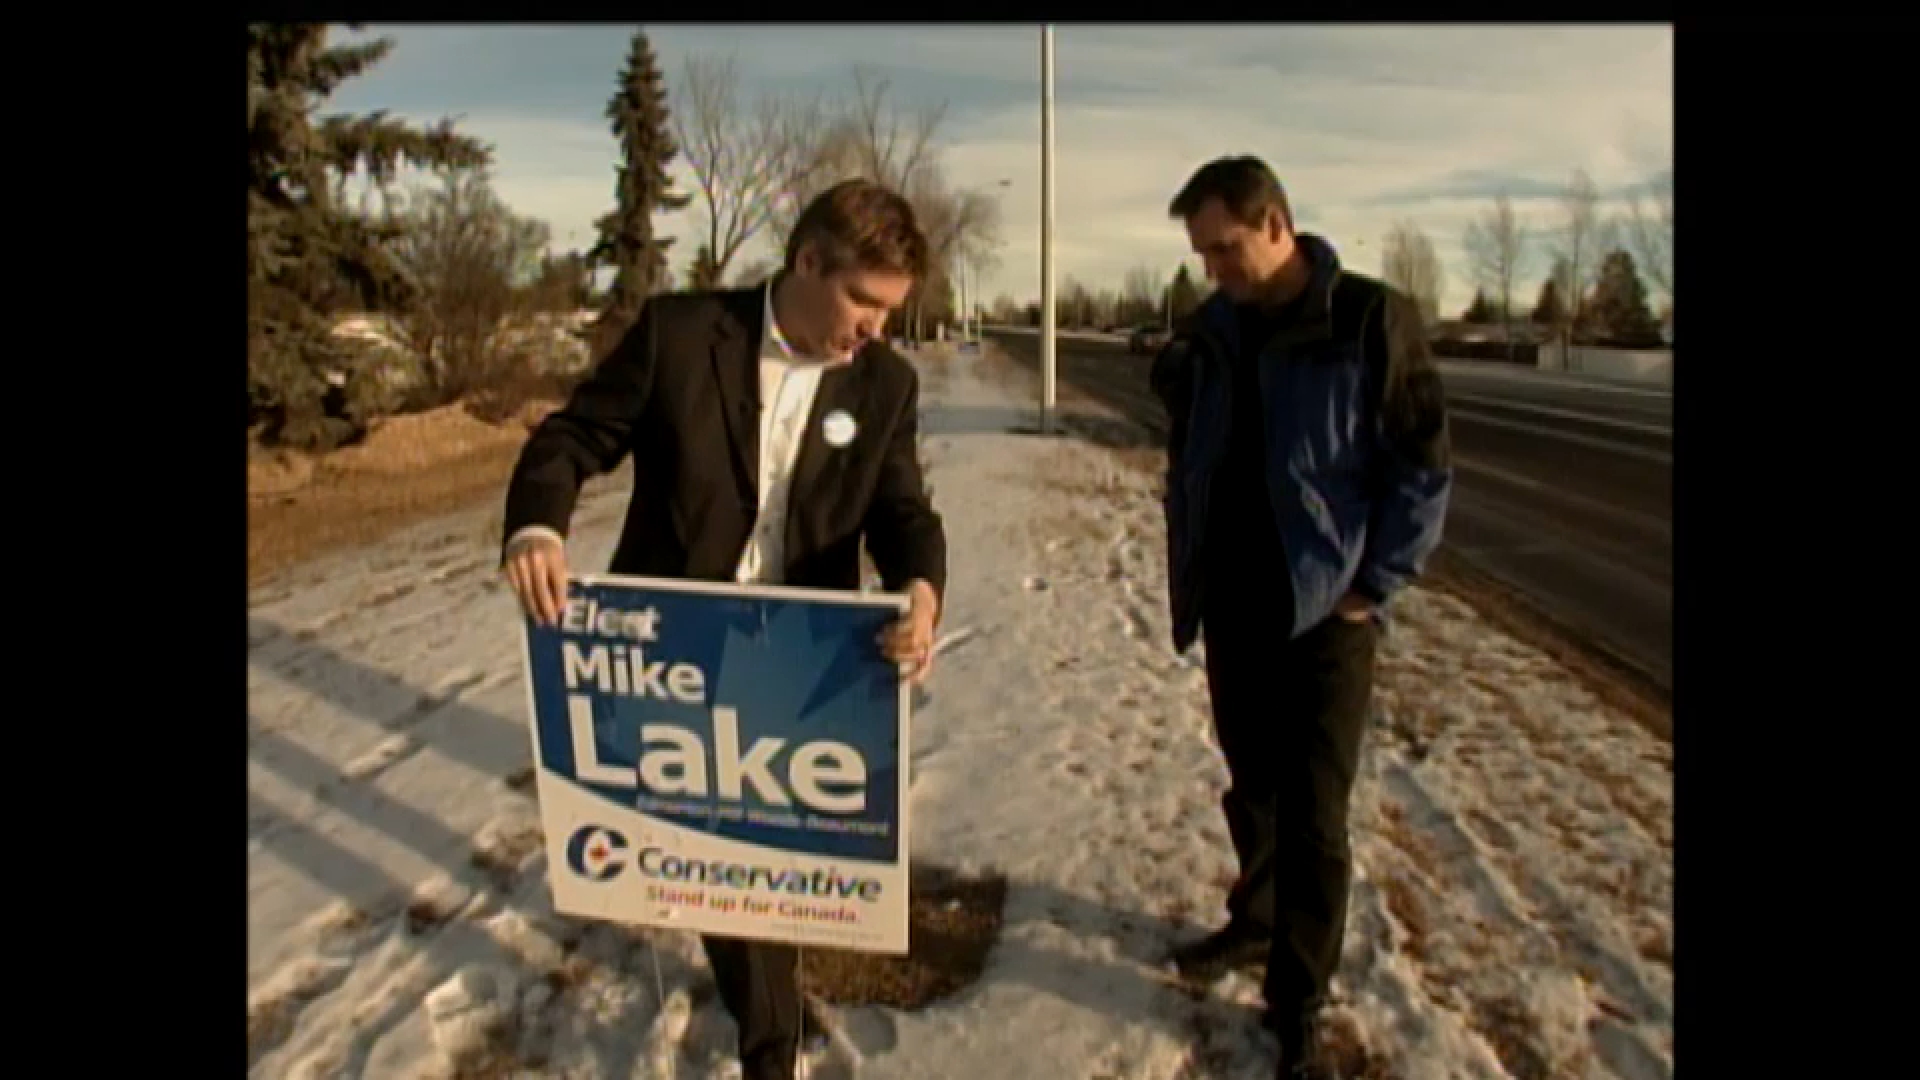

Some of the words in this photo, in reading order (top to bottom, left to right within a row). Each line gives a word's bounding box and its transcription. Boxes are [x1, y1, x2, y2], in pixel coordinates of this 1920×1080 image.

[562, 596, 661, 640] Elect
[562, 641, 705, 703] Mike
[567, 696, 867, 814] Lake
[638, 847, 882, 901] Conservative
[646, 886, 704, 906] Stand
[709, 896, 737, 912] up
[742, 895, 772, 911] for
[777, 901, 862, 923] Canada.
